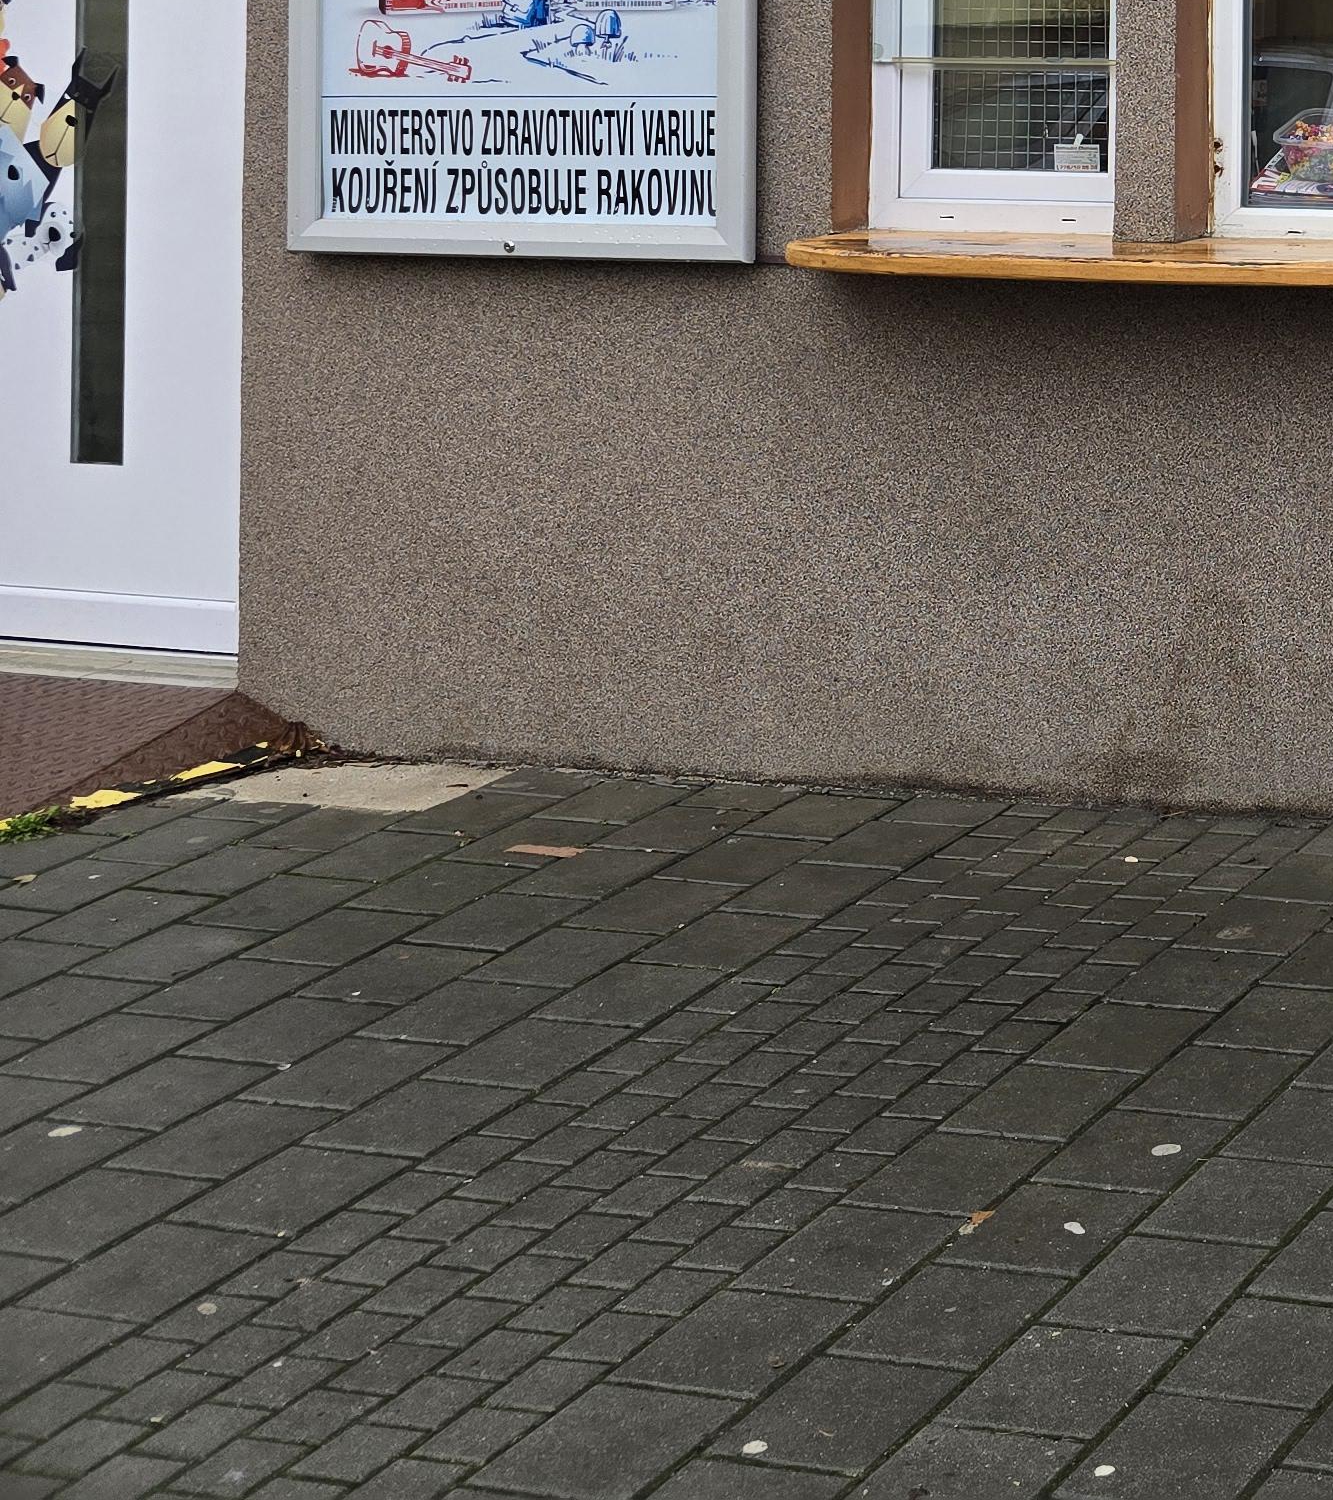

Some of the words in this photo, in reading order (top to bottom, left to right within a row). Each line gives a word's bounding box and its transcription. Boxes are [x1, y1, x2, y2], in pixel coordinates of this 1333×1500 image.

[330, 109, 473, 156] MINISTERSTVO
[481, 102, 635, 156] ZDRAVOTNICTVÍ
[331, 160, 440, 214] KOUŘENÍ
[446, 160, 587, 215] ZPŮSOBUJE
